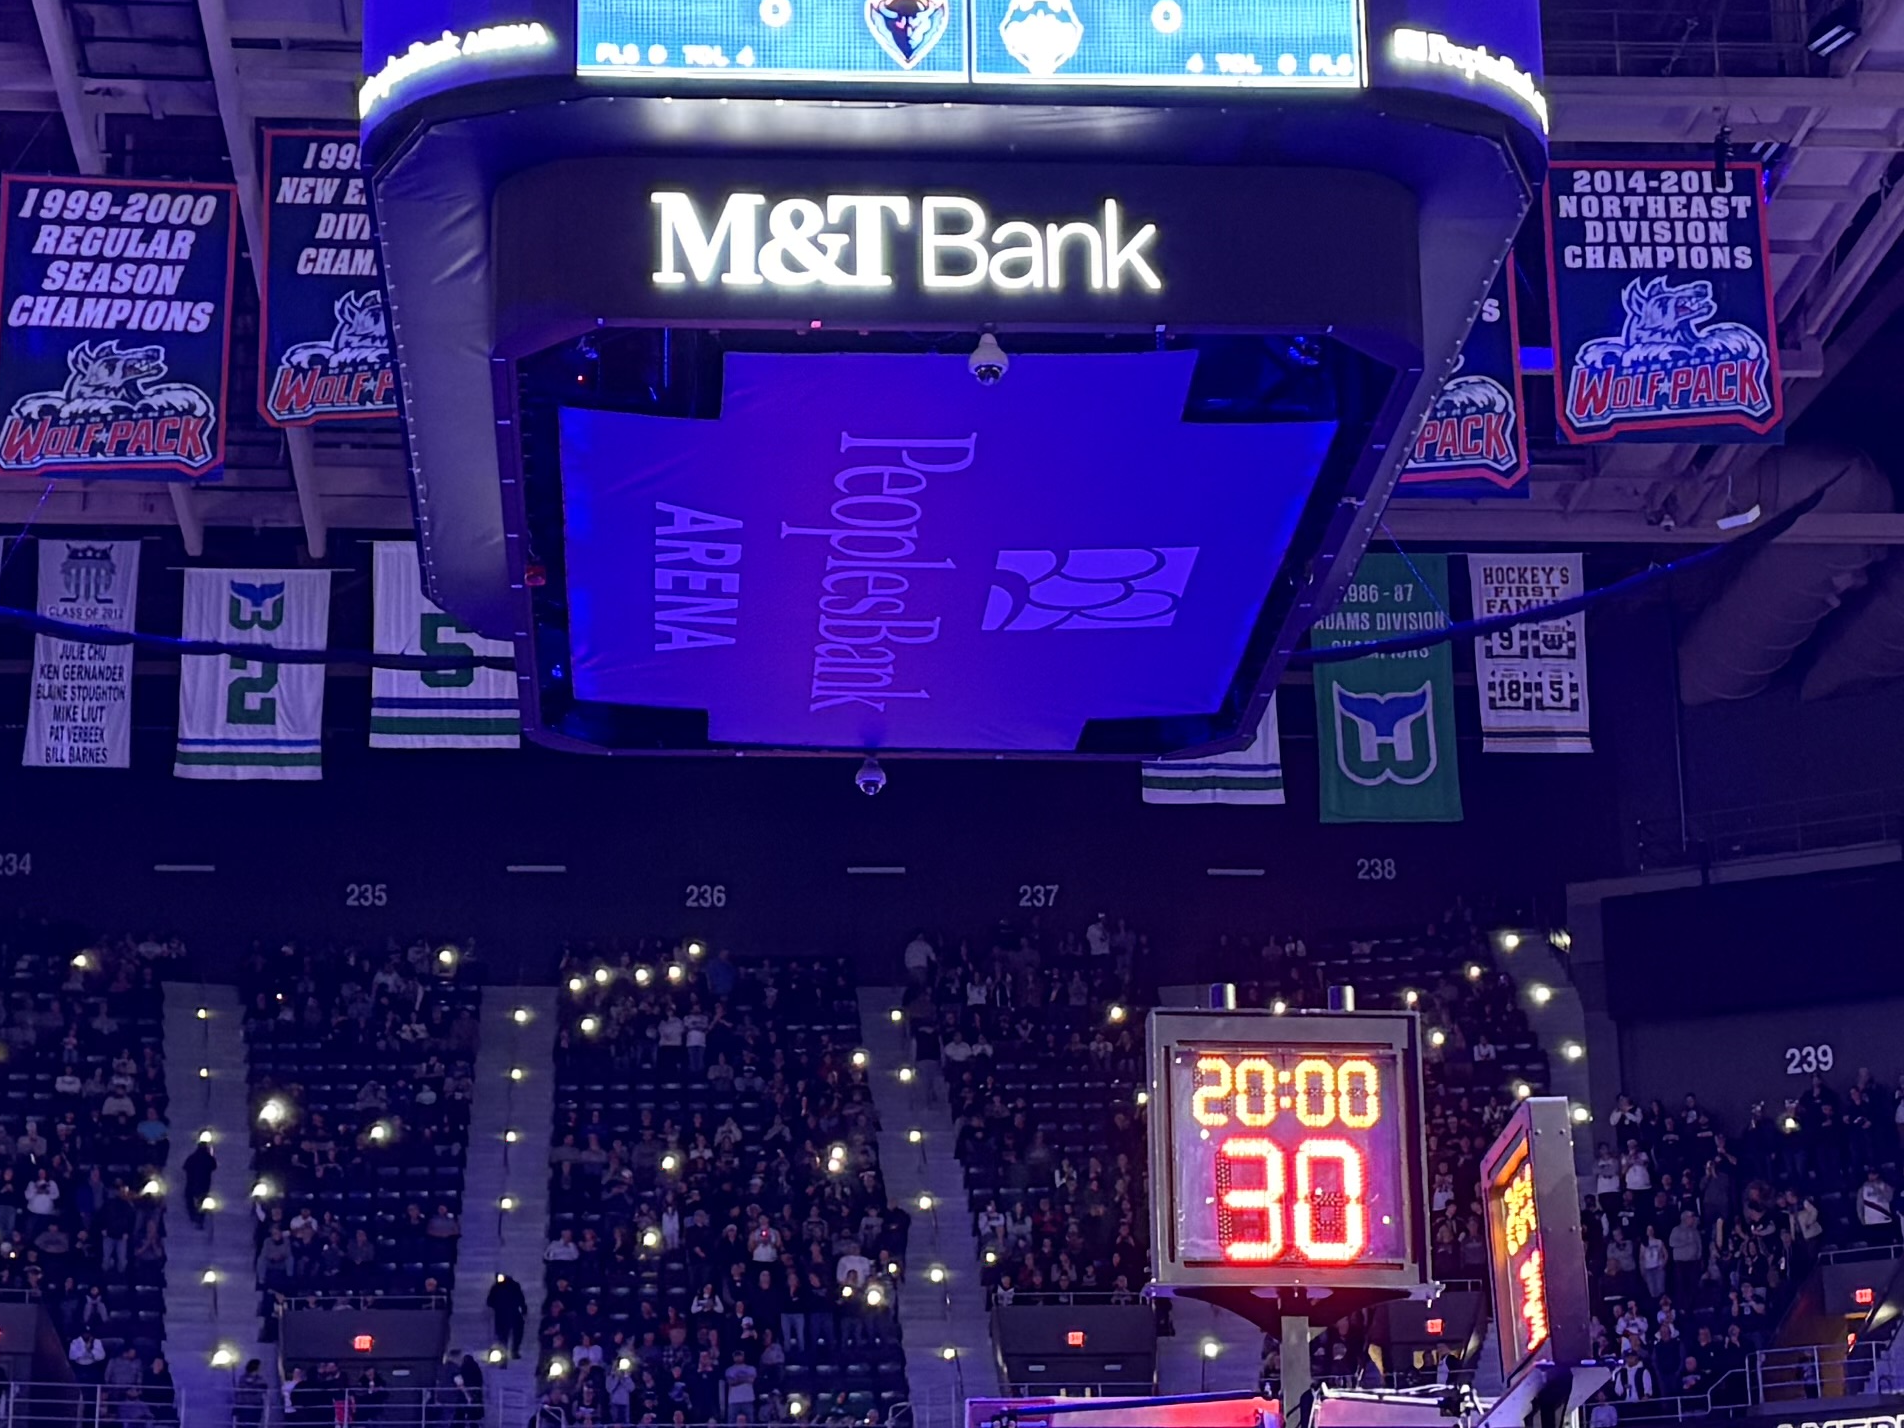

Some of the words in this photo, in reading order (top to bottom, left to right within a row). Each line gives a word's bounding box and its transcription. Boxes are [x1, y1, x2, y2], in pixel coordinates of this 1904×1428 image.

[275, 177, 340, 205] NEW
[17, 187, 218, 227] 1999-2000
[1558, 196, 1752, 219] NORTHEAST
[31, 224, 197, 261] REGULAR
[650, 192, 910, 287] M&T
[921, 196, 1163, 291] Bank
[1585, 220, 1728, 244] DIVISION
[1564, 245, 1753, 270] CHAMPIONS
[40, 259, 186, 296] SEASON
[7, 294, 216, 334] CHAMPIONS
[652, 500, 744, 653] ARENA
[779, 430, 978, 714] PeoplesBank
[1484, 566, 1570, 585] HOCKEY'S
[1394, 583, 1414, 603] 87
[1493, 586, 1560, 598] FIRST
[48, 606, 84, 618] CLASS
[86, 607, 100, 618] OF
[1313, 611, 1370, 632] ADAMS
[1375, 611, 1446, 632] DIVISION
[59, 643, 86, 662] JULIE
[87, 644, 107, 662] CHU
[421, 612, 475, 689] 5
[39, 663, 61, 681] KEN
[62, 663, 125, 682] GERNANDER
[70, 684, 127, 702] STOUGHTON
[1498, 679, 1522, 703] 18
[1549, 679, 1564, 704] 5
[52, 704, 80, 723] MIKE
[81, 704, 106, 723] LIUT
[49, 725, 66, 742] PAT
[45, 747, 65, 764] BILL
[66, 747, 108, 766] BARNES
[1356, 858, 1396, 880] 238
[345, 884, 388, 906] 235
[685, 885, 726, 908] 236
[1018, 885, 1059, 908] 237
[1785, 1044, 1834, 1075] 239
[1192, 1055, 1379, 1128] 20:00
[1216, 1137, 1363, 1262] 30
